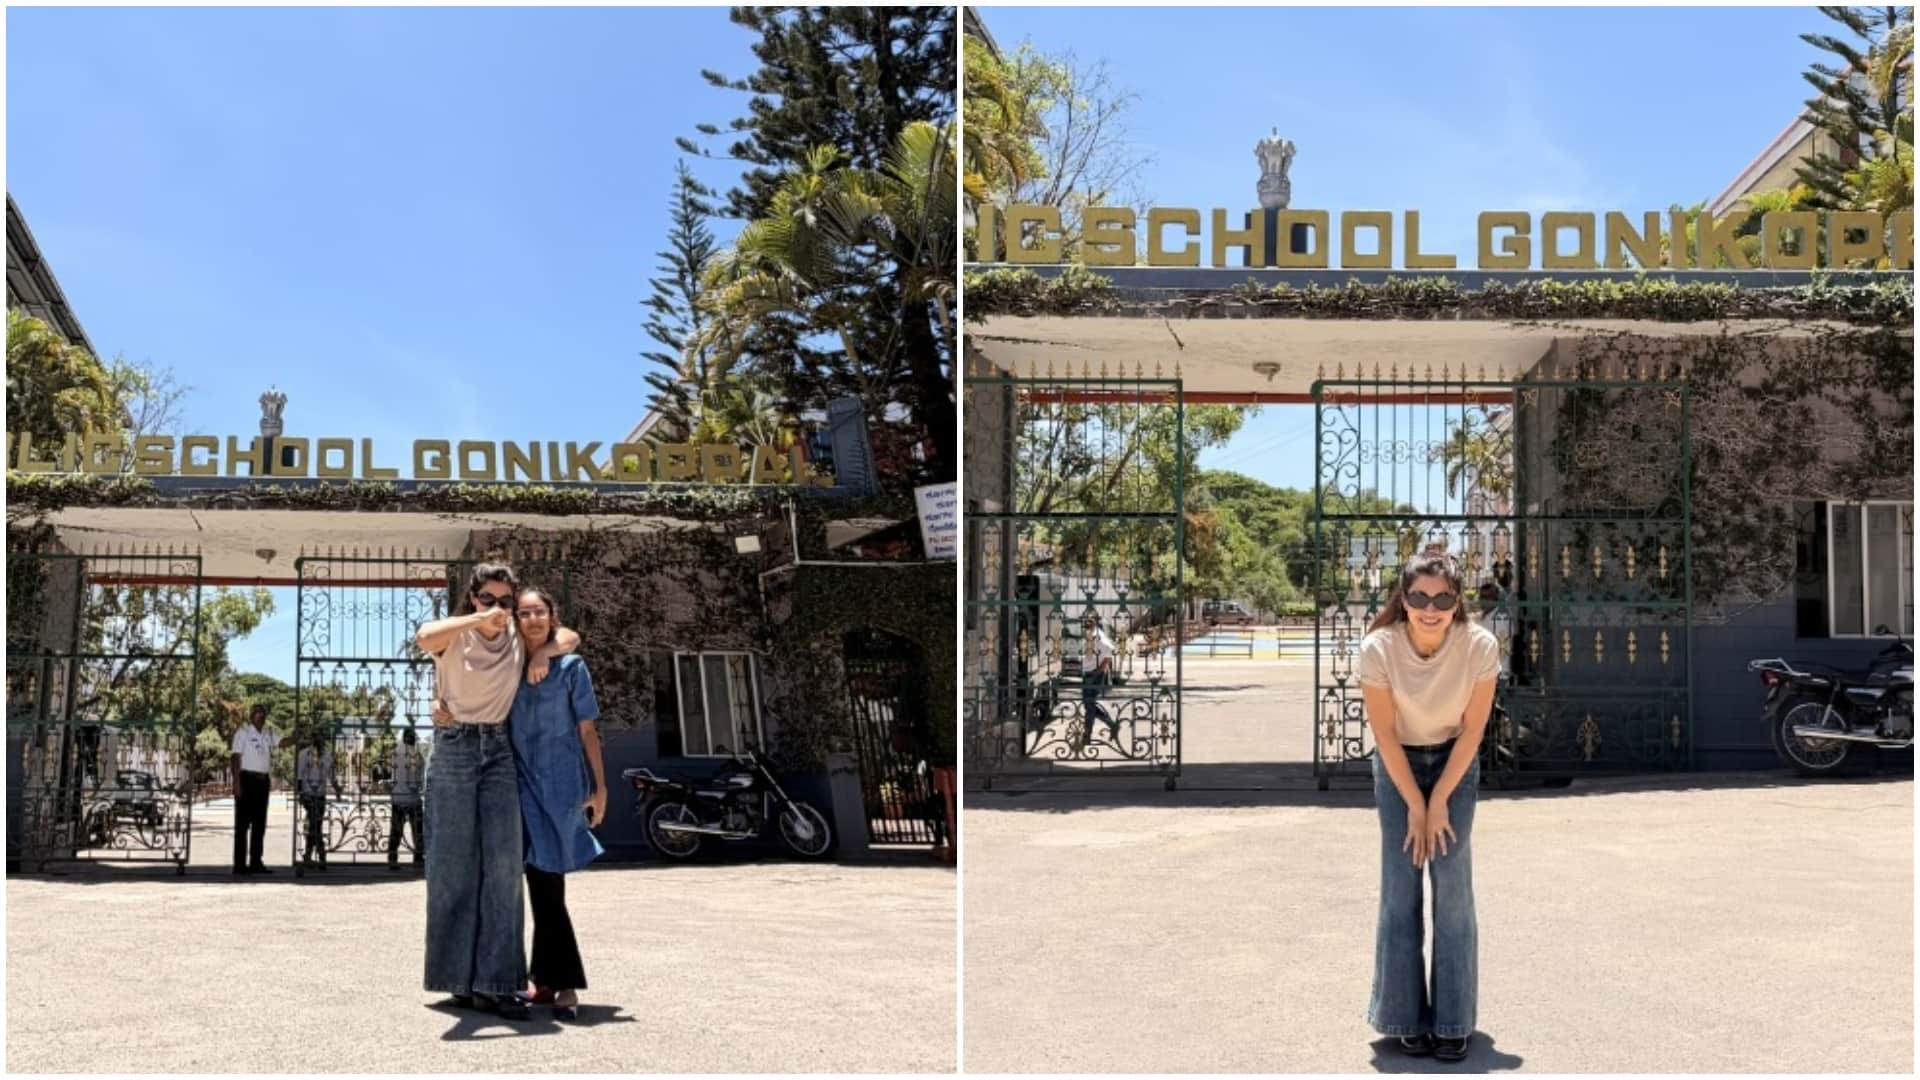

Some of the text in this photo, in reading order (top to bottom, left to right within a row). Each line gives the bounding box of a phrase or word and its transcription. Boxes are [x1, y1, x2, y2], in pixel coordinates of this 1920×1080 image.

[979, 203, 1062, 264] IC
[1082, 206, 1457, 268] SCHOOL
[6, 431, 835, 488] LIC SCHOOL GONIKOPPAL
